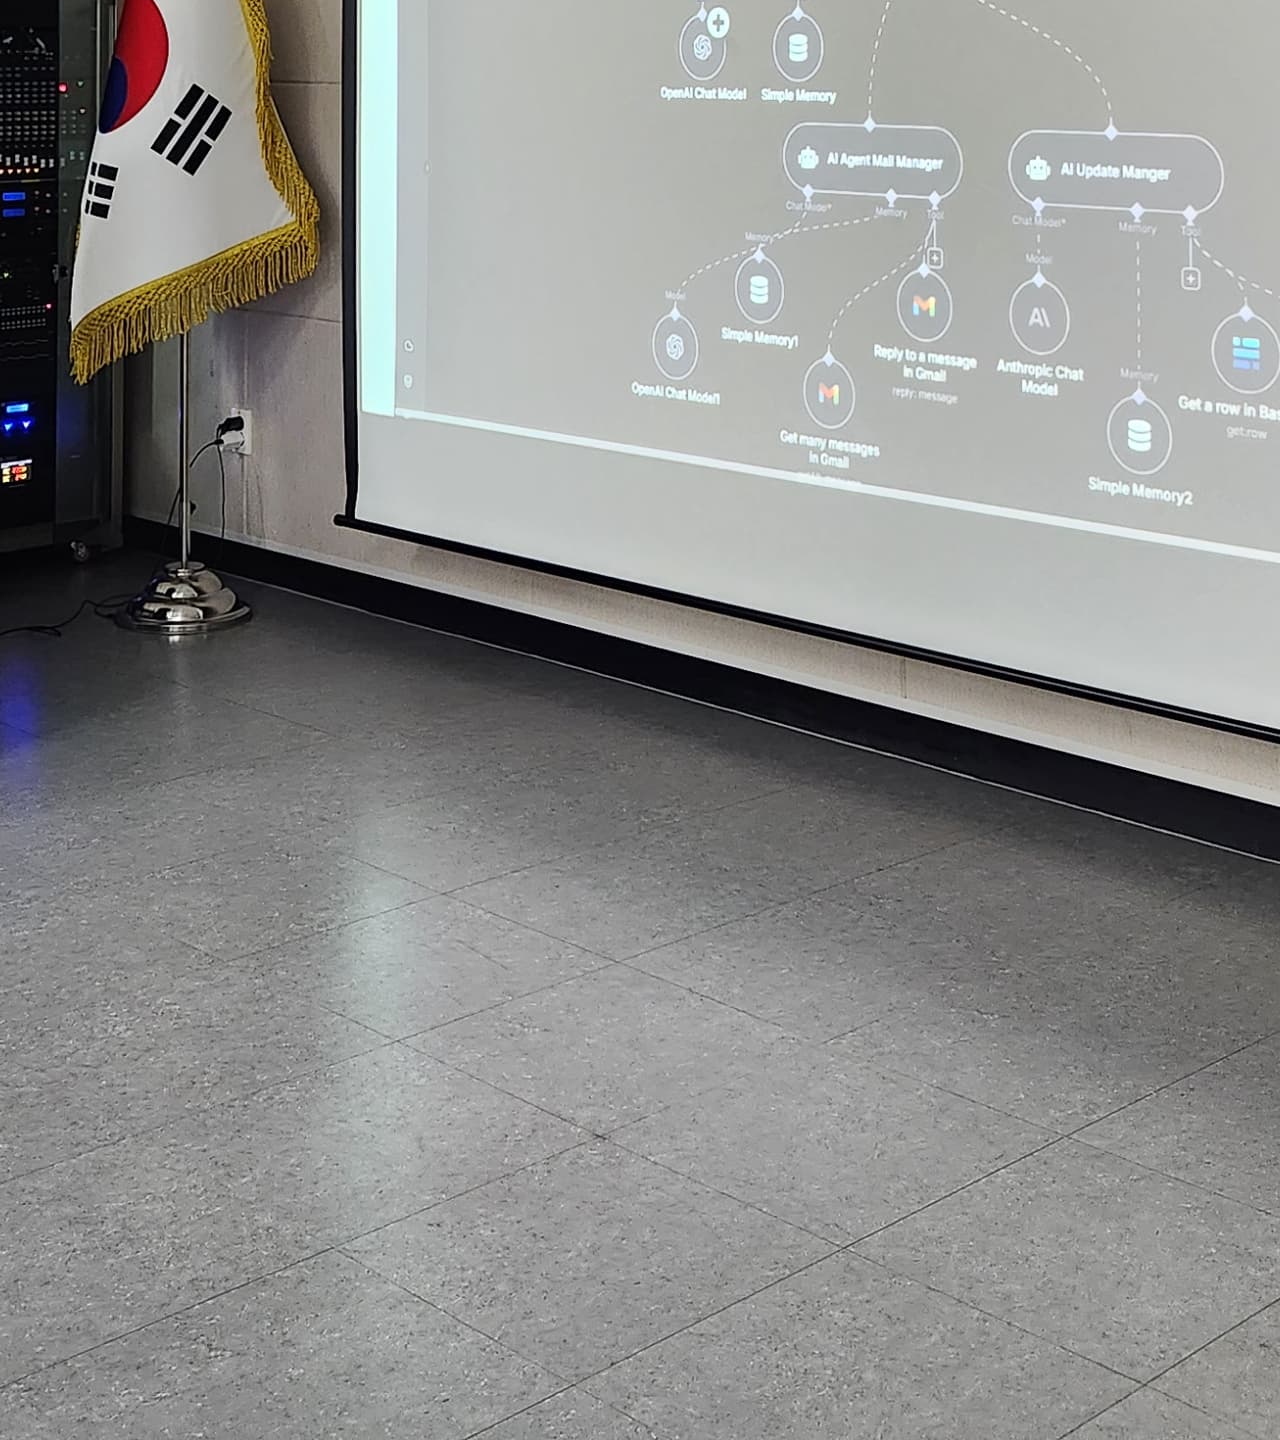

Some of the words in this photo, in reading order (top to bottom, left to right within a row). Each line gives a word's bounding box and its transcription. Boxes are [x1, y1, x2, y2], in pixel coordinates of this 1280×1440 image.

[660, 86, 693, 100] OpenAI
[694, 87, 717, 100] Chat
[718, 88, 747, 100] Model
[761, 88, 793, 103] Simple
[795, 89, 837, 105] Memory
[827, 152, 838, 165] AI
[839, 153, 870, 168] Agent
[872, 155, 894, 168] Mail
[895, 155, 943, 172] Manager
[1061, 162, 1074, 176] AI
[1076, 163, 1120, 179] Update
[1122, 164, 1171, 183] Manger
[785, 200, 804, 211] Chat
[875, 207, 907, 220] Memory
[927, 210, 944, 221] Tool
[1012, 215, 1033, 226] Chat
[745, 231, 774, 244] Memory
[1119, 222, 1157, 236] Memory
[1181, 226, 1200, 237] Tool
[1026, 253, 1053, 264] Model
[665, 290, 687, 300] Model
[721, 327, 753, 343] Simple
[754, 330, 799, 350] Memory1
[873, 344, 904, 362] Reply
[905, 348, 917, 361] to
[927, 353, 977, 371] message
[903, 365, 914, 378] in
[915, 367, 947, 383] Gmail
[996, 358, 1054, 379] Anthropic
[1055, 365, 1085, 382] Chat
[1120, 367, 1160, 383] Memory
[631, 381, 664, 398] OpenAI
[665, 386, 687, 401] Chat
[892, 386, 917, 400] reply:
[918, 389, 958, 405] message
[1021, 379, 1059, 396] Model
[1178, 395, 1202, 411] Get
[1204, 401, 1213, 412] a
[1215, 404, 1240, 415] row
[1244, 405, 1257, 418] in
[780, 429, 799, 444] Get
[799, 434, 827, 450] many
[828, 439, 880, 458] messages
[809, 450, 819, 463] in
[820, 453, 850, 469] Gmail
[1088, 475, 1130, 496] Simple
[1131, 482, 1193, 507] Memory2
